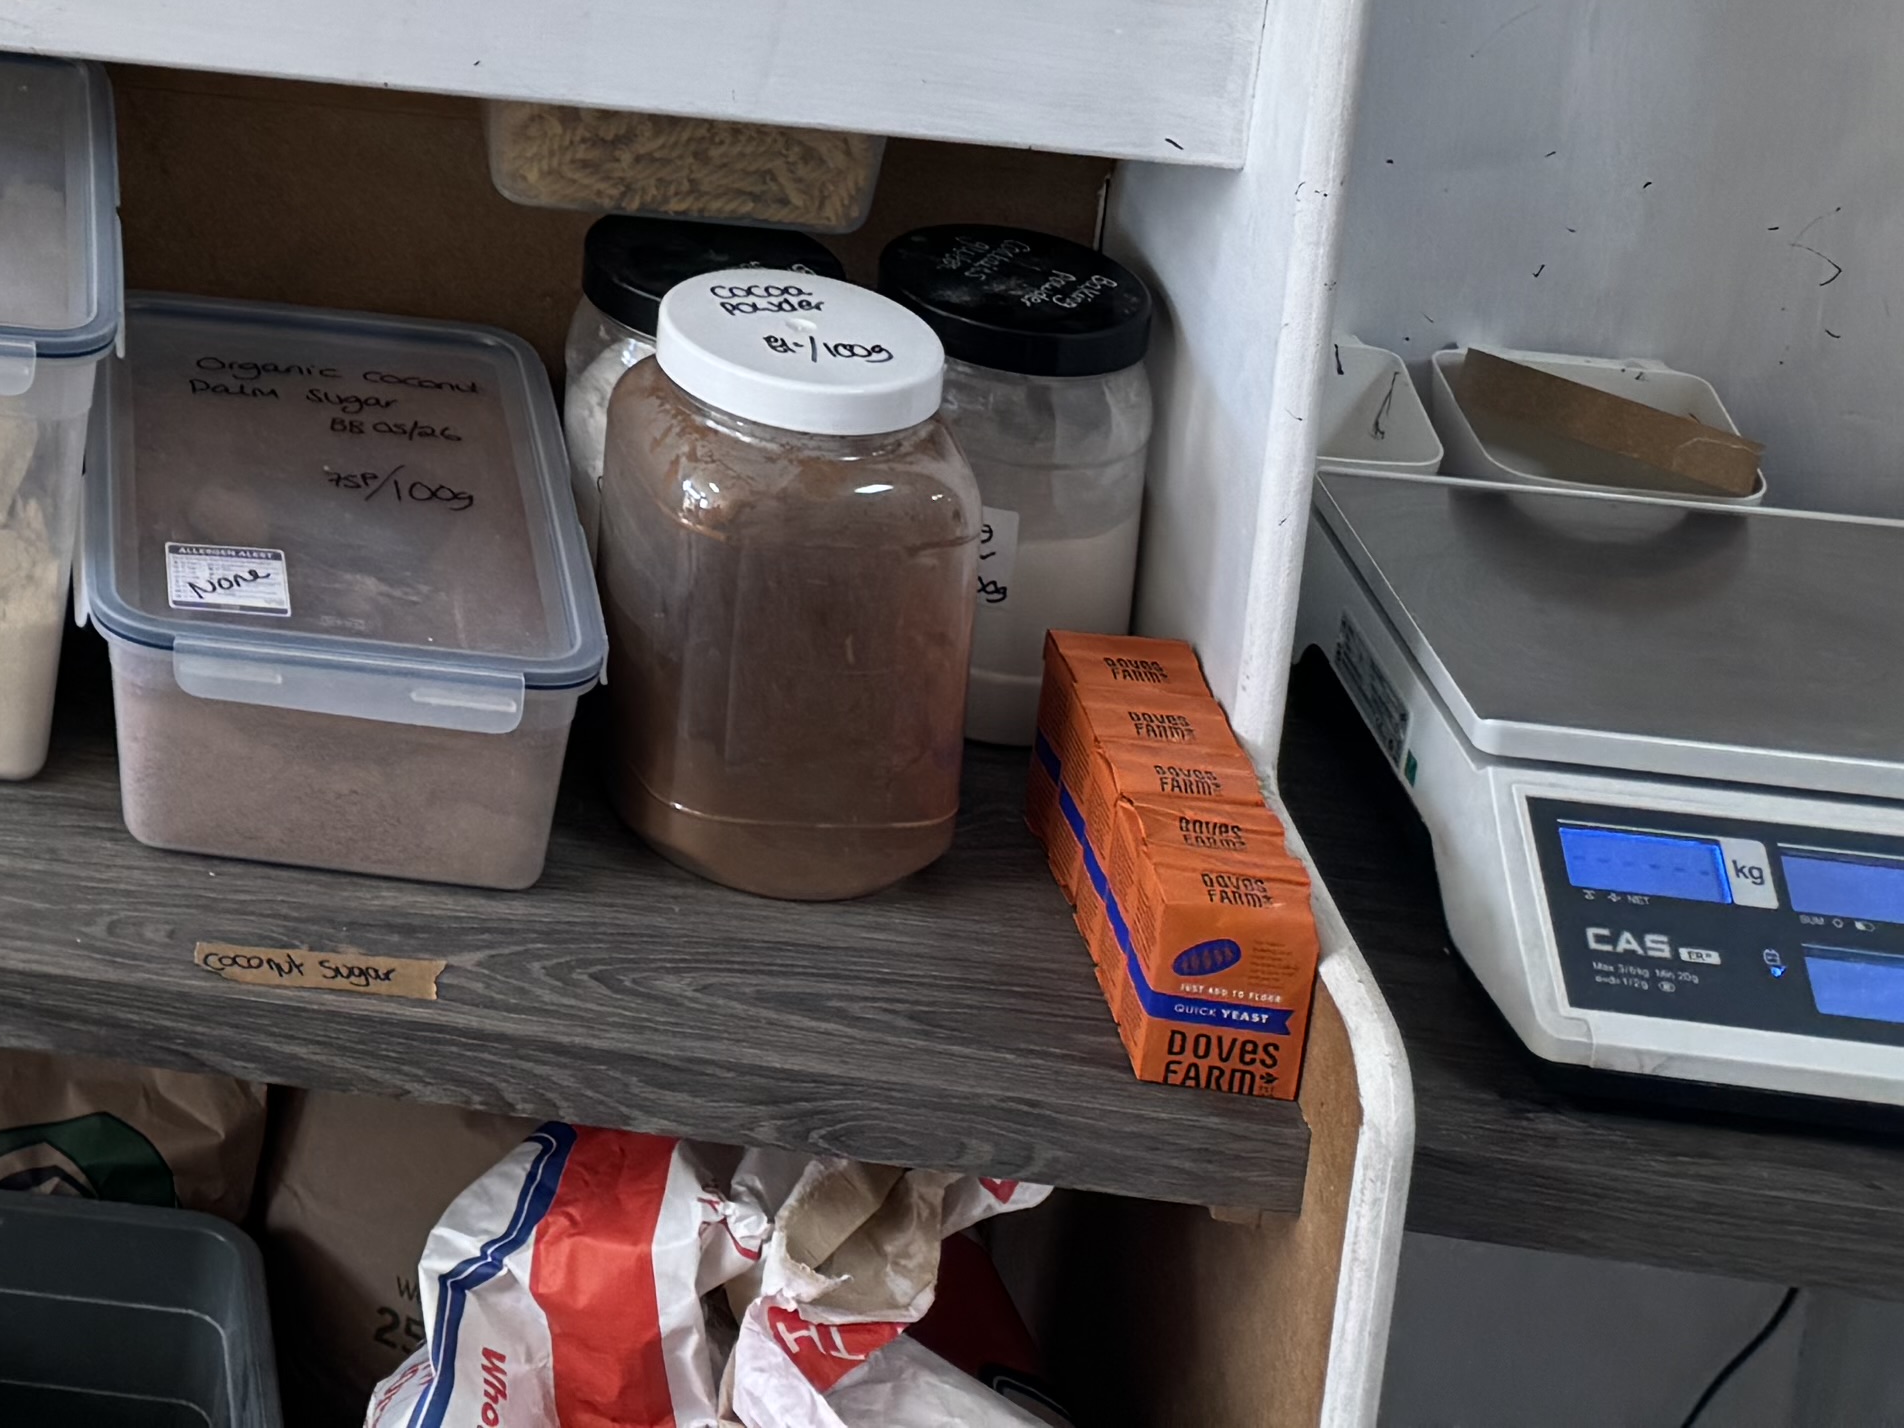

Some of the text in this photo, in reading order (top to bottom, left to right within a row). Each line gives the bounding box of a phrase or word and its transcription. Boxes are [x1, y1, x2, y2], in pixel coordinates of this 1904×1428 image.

[195, 356, 342, 380] Organic
[328, 418, 463, 443] BB 05/26
[187, 567, 272, 600] None
[1110, 667, 1161, 684] FARM
[1133, 721, 1185, 740] FARM
[1158, 776, 1212, 796] FARM
[1731, 860, 1766, 886] kg
[1206, 889, 1262, 909] FARM
[1584, 926, 1673, 959] CAS
[1173, 1002, 1270, 1024] QUICK YEAST
[1162, 1059, 1256, 1097] FARM
